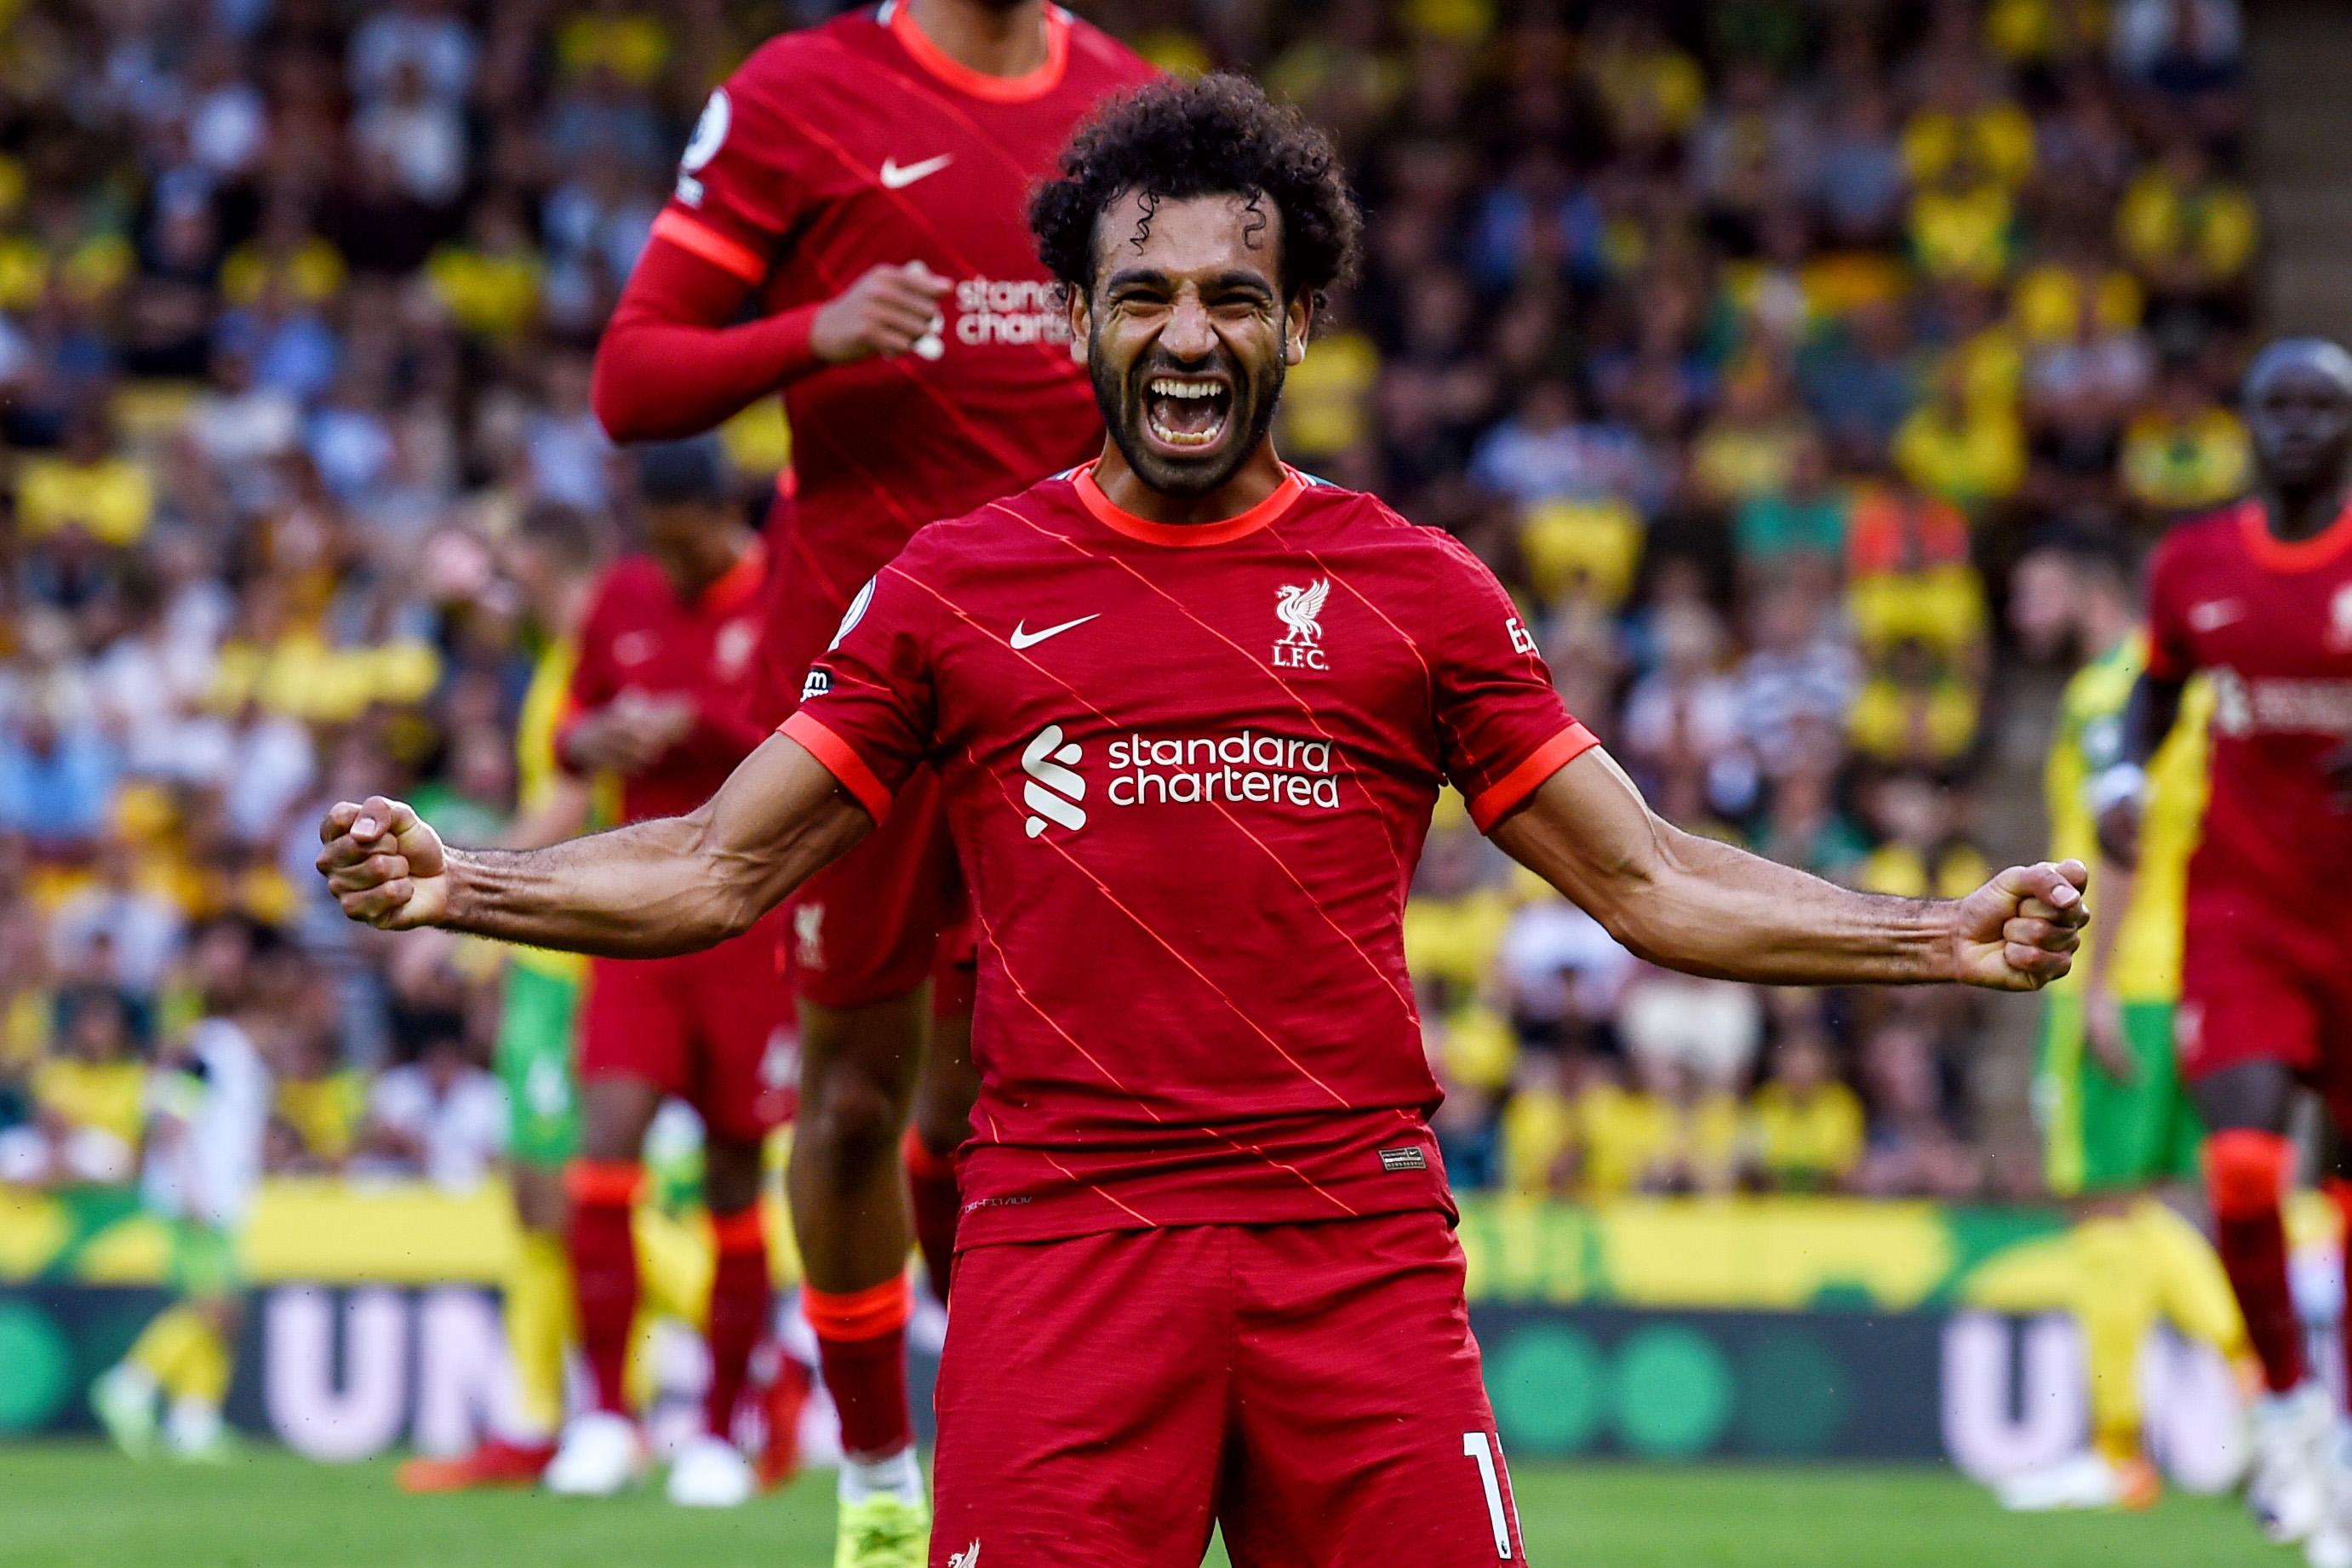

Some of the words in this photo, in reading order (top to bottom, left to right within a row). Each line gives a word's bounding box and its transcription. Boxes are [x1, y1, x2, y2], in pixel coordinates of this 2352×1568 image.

[1273, 645, 1330, 671] L.F.C.
[1108, 730, 1332, 773] standard
[1108, 764, 1340, 808] chartered
[262, 1283, 564, 1462] UN
